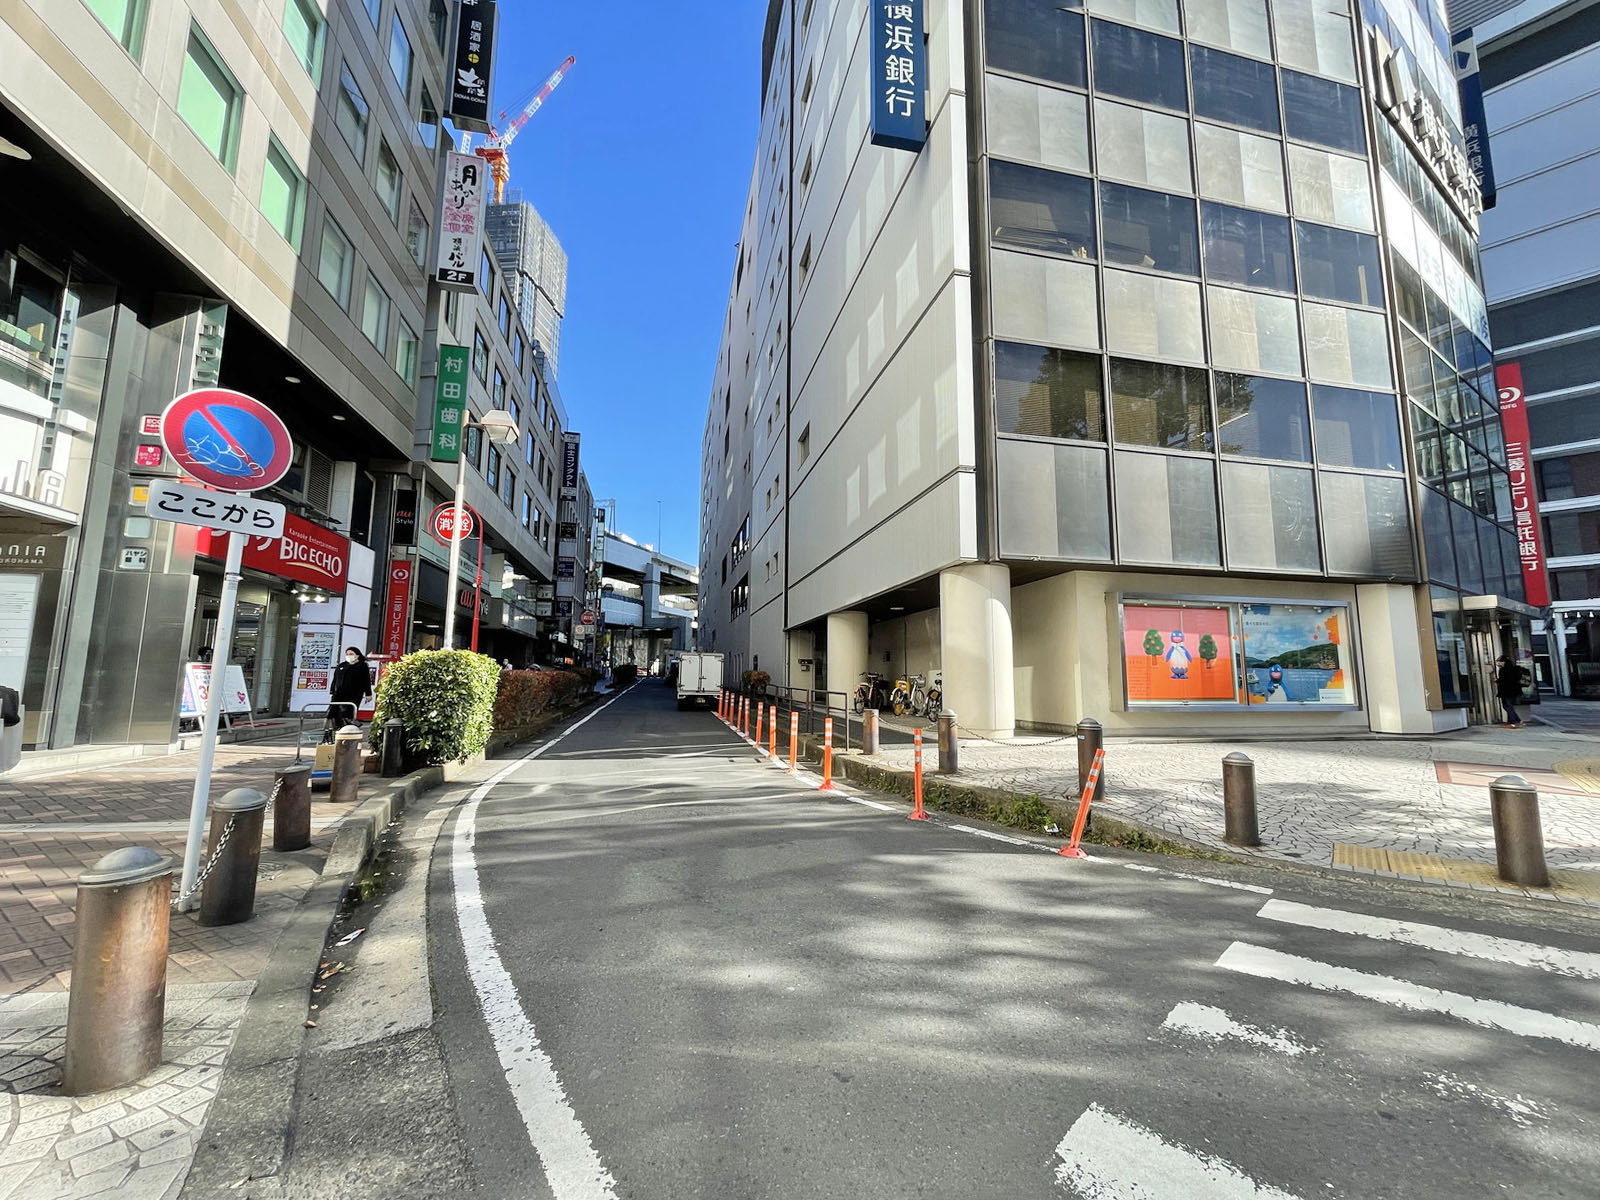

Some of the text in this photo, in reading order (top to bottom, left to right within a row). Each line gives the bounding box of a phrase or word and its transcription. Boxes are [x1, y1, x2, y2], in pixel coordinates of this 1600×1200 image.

[447, 271, 467, 281] 2F
[438, 356, 463, 450] 村田歯科
[158, 490, 276, 530] ここから
[280, 537, 307, 560] BIG
[309, 550, 343, 577] ECHO
